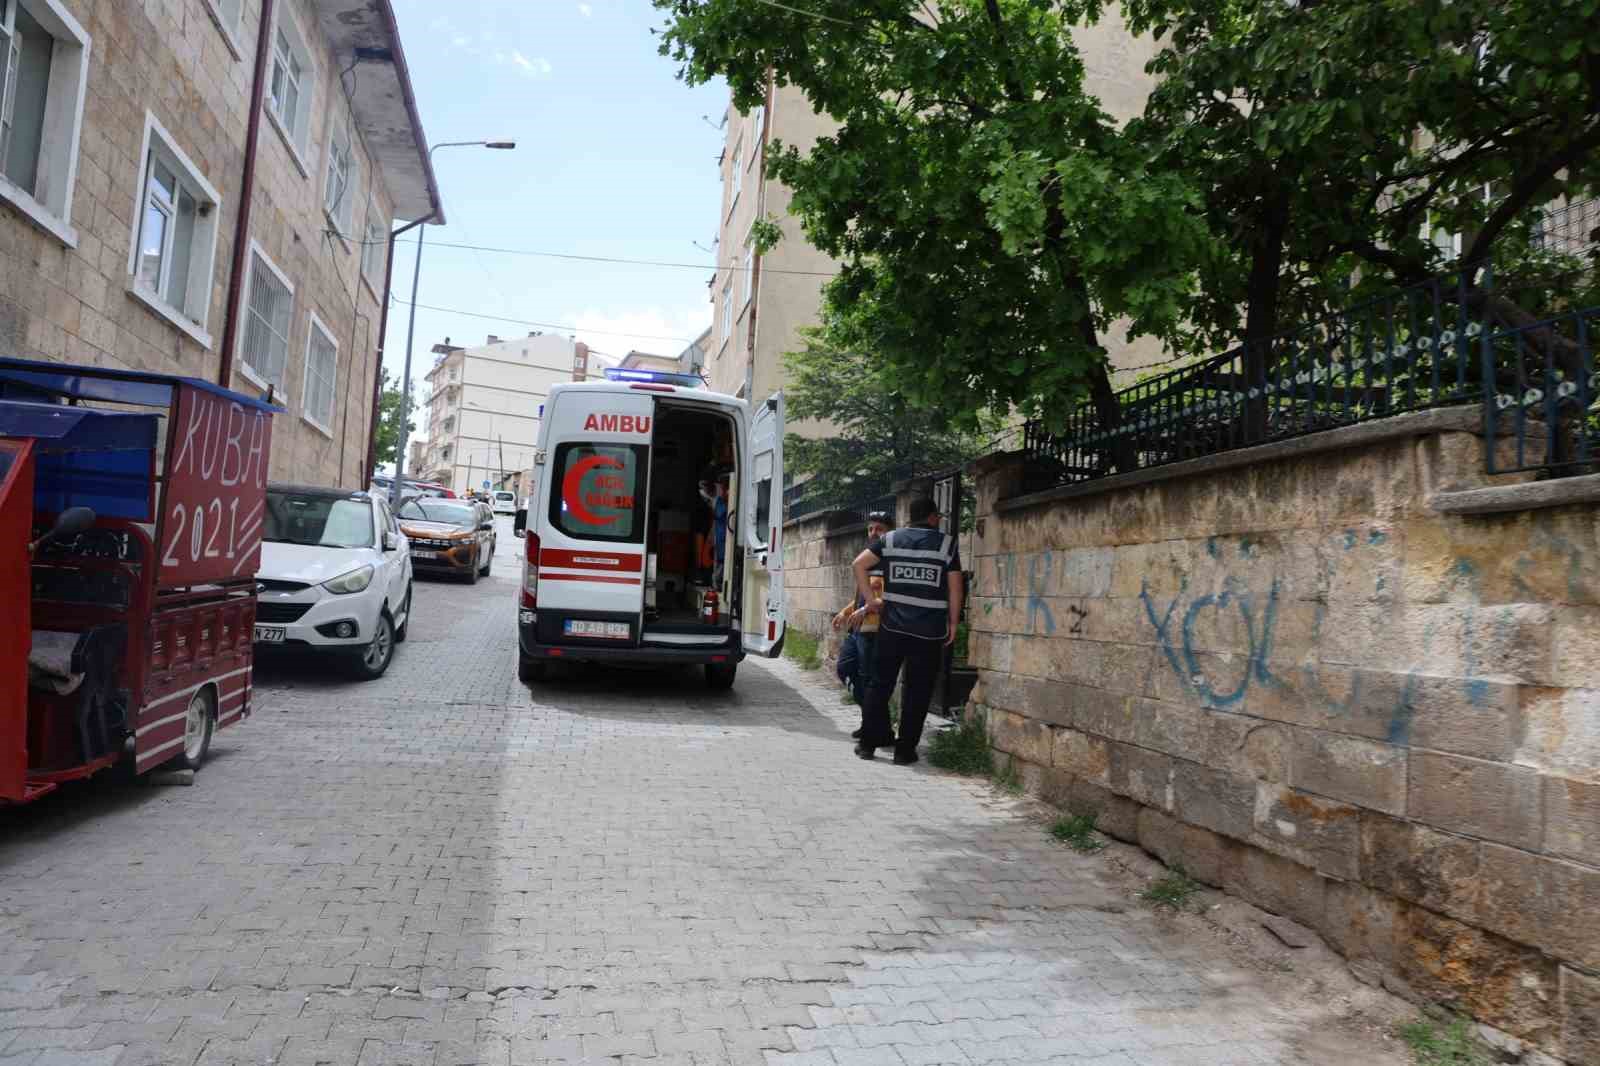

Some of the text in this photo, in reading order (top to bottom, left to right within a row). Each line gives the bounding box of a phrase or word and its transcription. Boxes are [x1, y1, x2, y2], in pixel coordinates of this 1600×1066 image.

[174, 391, 264, 489] KUBA
[584, 413, 650, 433] AMBU
[162, 497, 239, 567] 2021
[264, 628, 284, 640] 277
